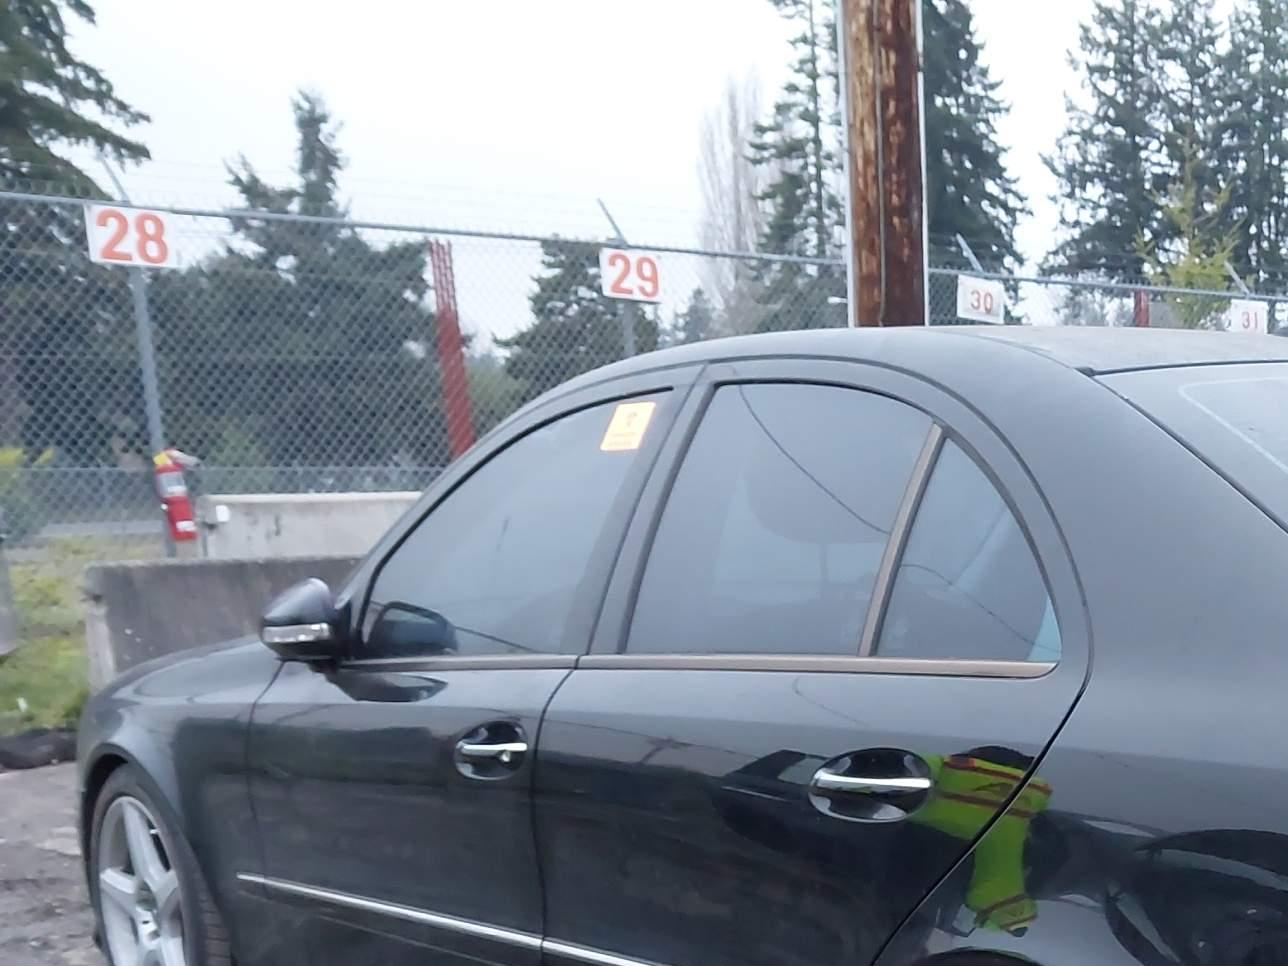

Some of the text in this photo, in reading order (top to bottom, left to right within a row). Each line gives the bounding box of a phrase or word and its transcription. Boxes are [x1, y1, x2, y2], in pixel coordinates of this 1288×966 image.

[96, 209, 169, 264] 28
[608, 253, 659, 298] 29
[971, 290, 994, 314] 30
[1241, 311, 1258, 329] 31
